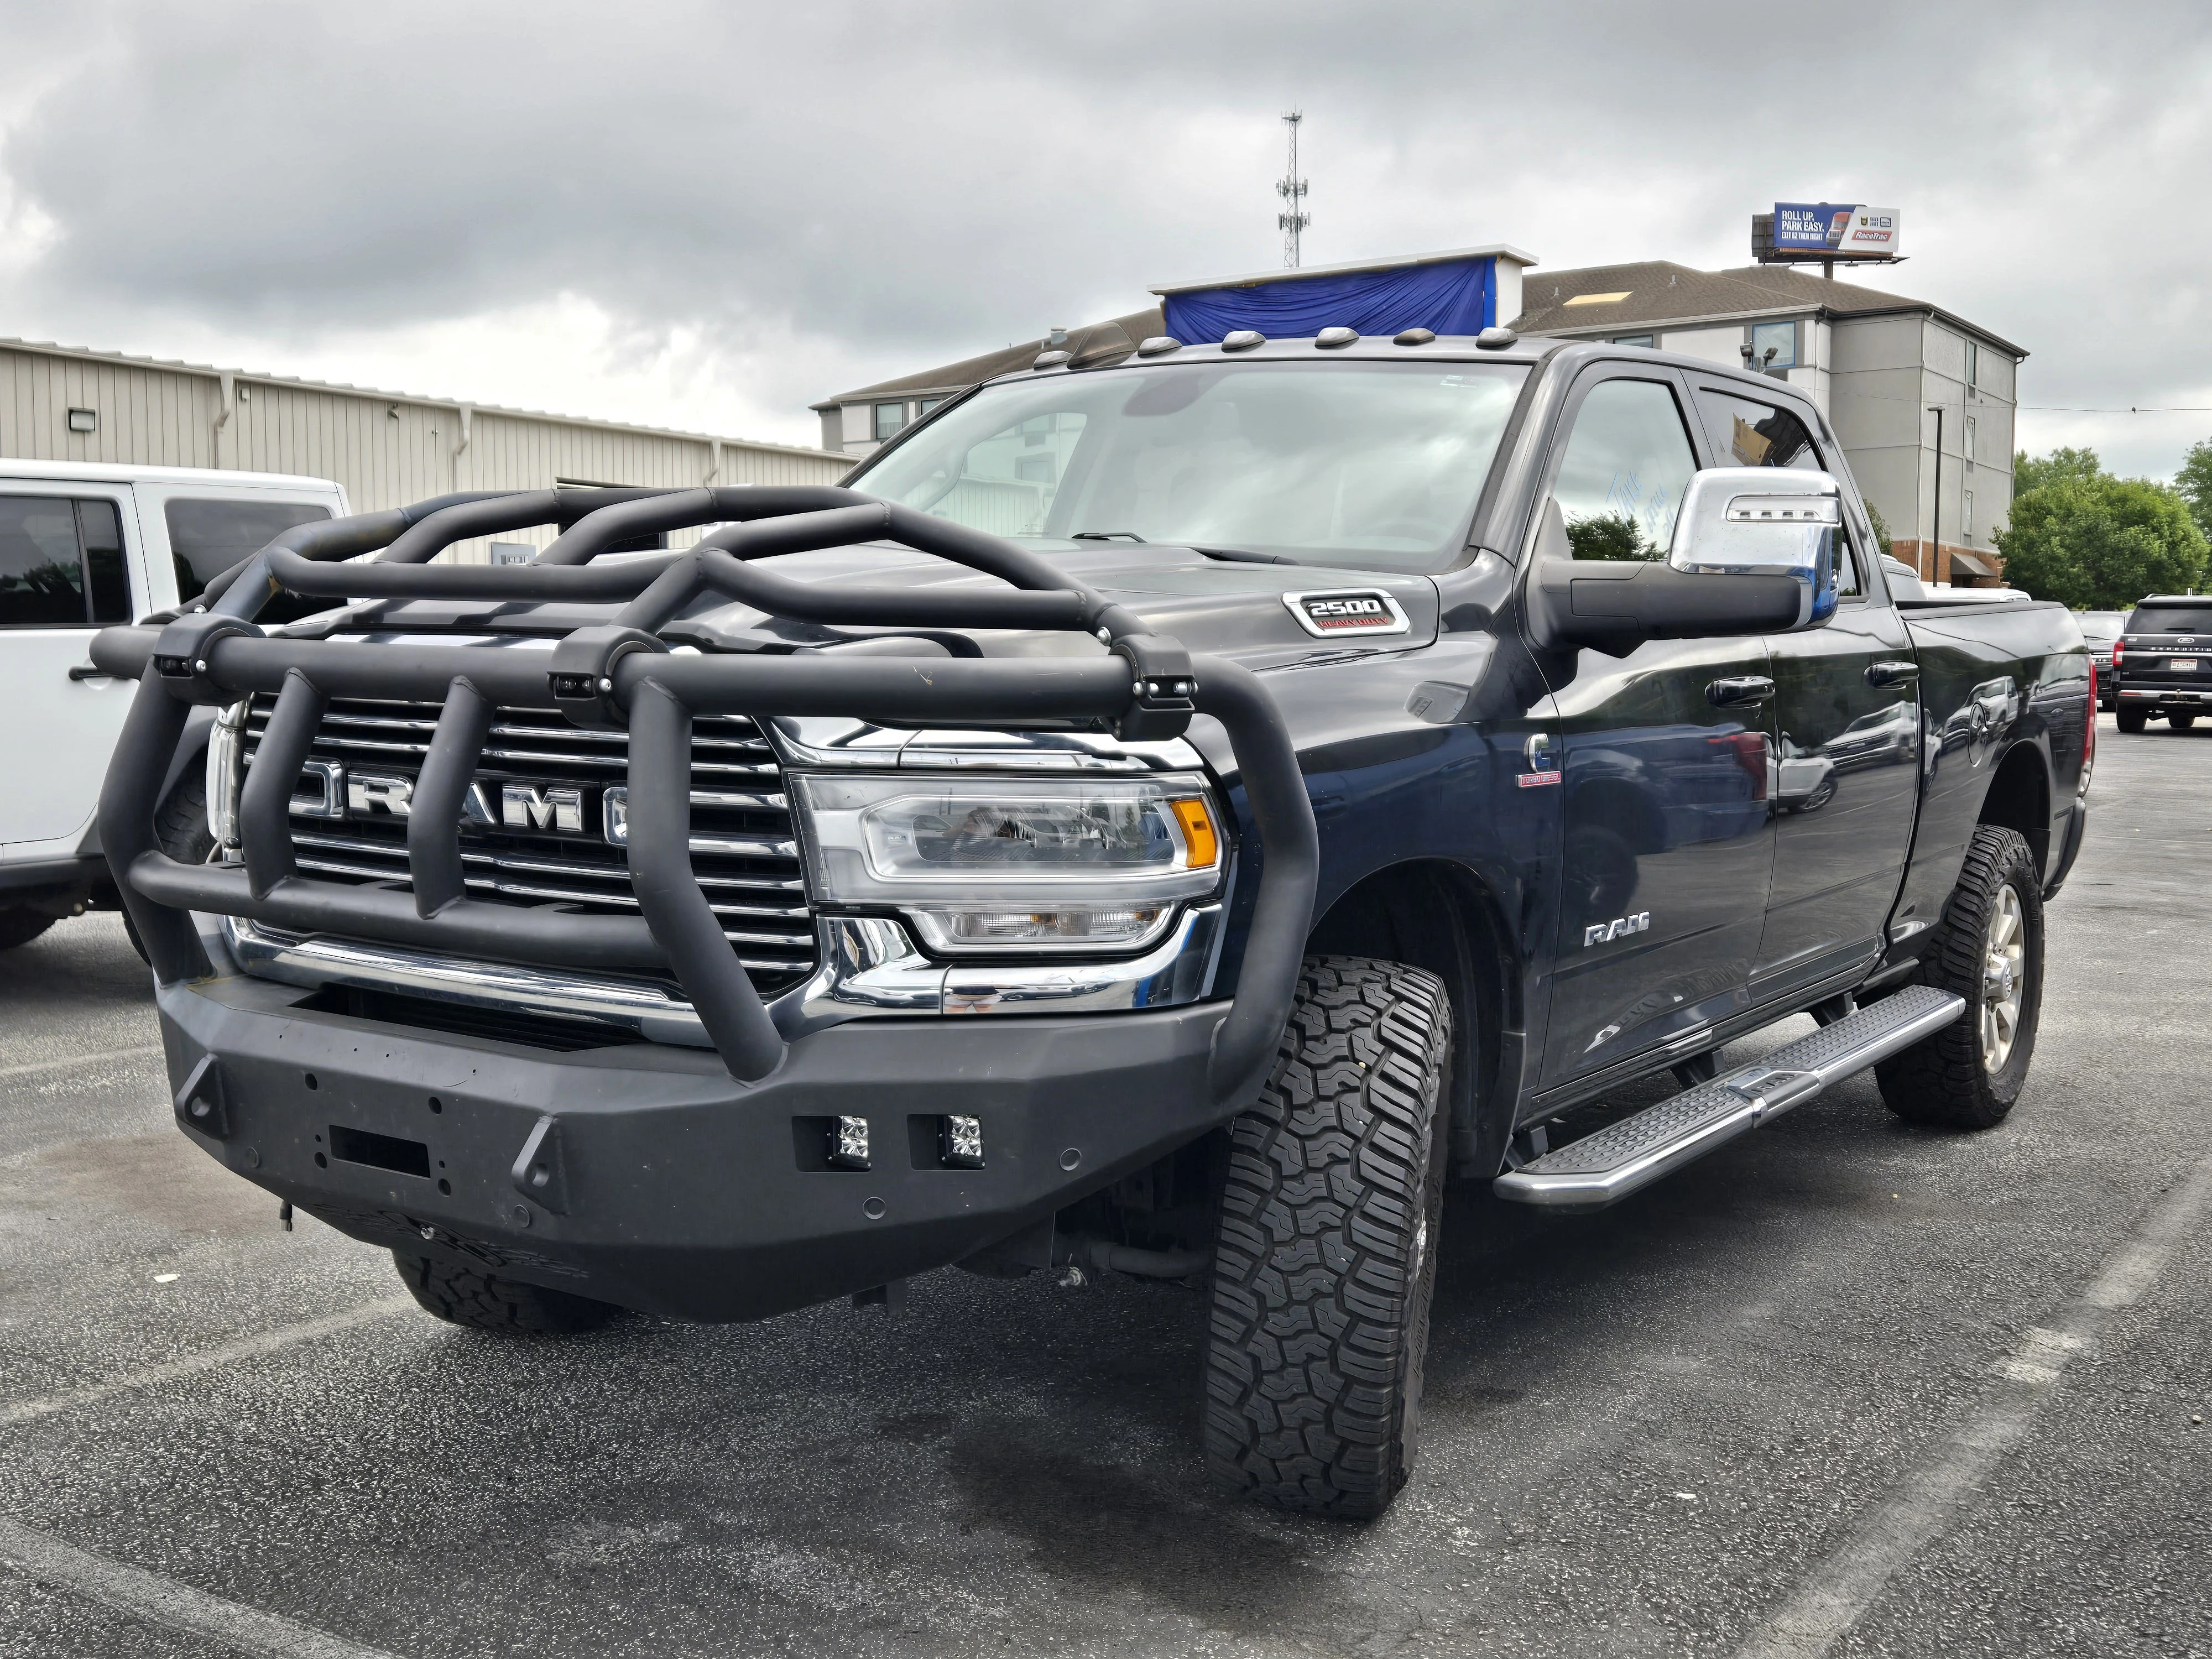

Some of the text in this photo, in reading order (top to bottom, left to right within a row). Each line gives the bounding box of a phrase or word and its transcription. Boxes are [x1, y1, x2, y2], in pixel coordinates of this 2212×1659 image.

[1782, 210, 1801, 220] ROLL
[1782, 221, 1824, 232] PARK EASY.
[1307, 599, 1381, 617] 2500
[1584, 911, 1650, 947] RAM
